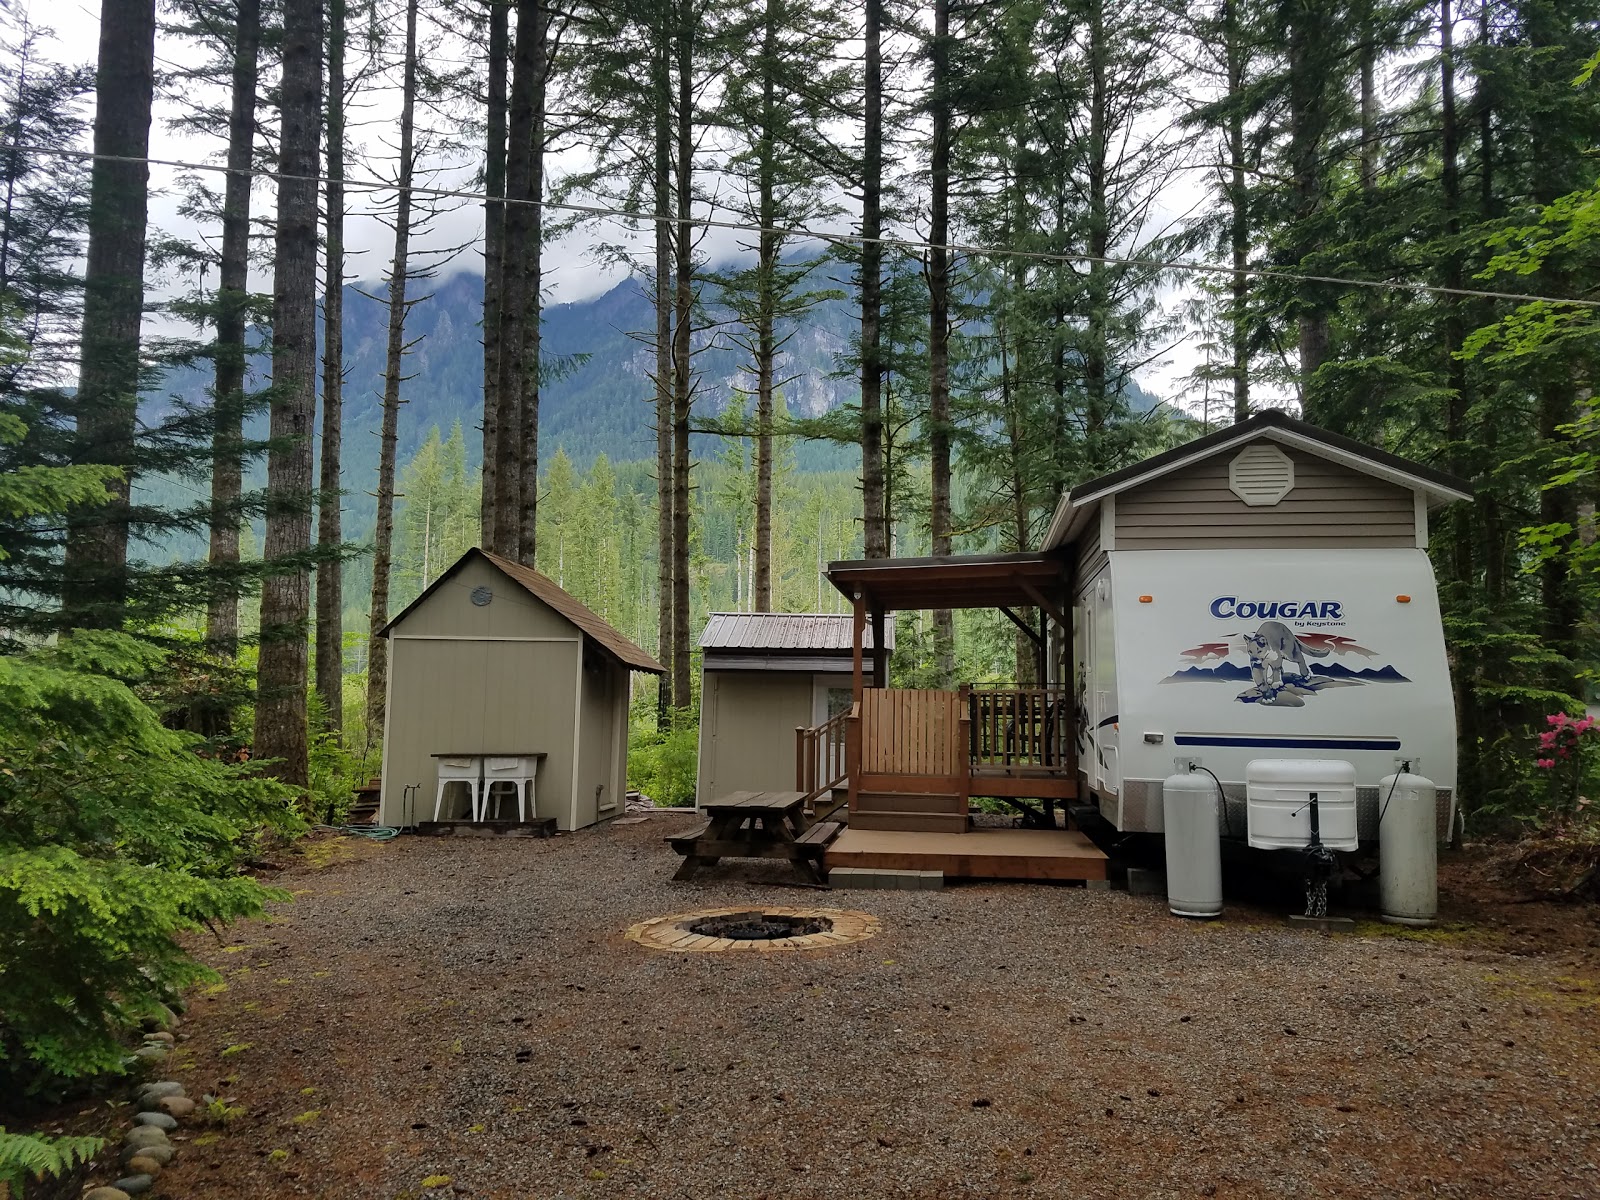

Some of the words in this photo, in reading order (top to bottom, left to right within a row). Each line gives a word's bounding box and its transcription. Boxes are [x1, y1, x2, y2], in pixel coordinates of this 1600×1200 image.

[1210, 596, 1342, 619] COUGAR
[1294, 620, 1305, 628] by
[1306, 620, 1346, 628] Keystone
